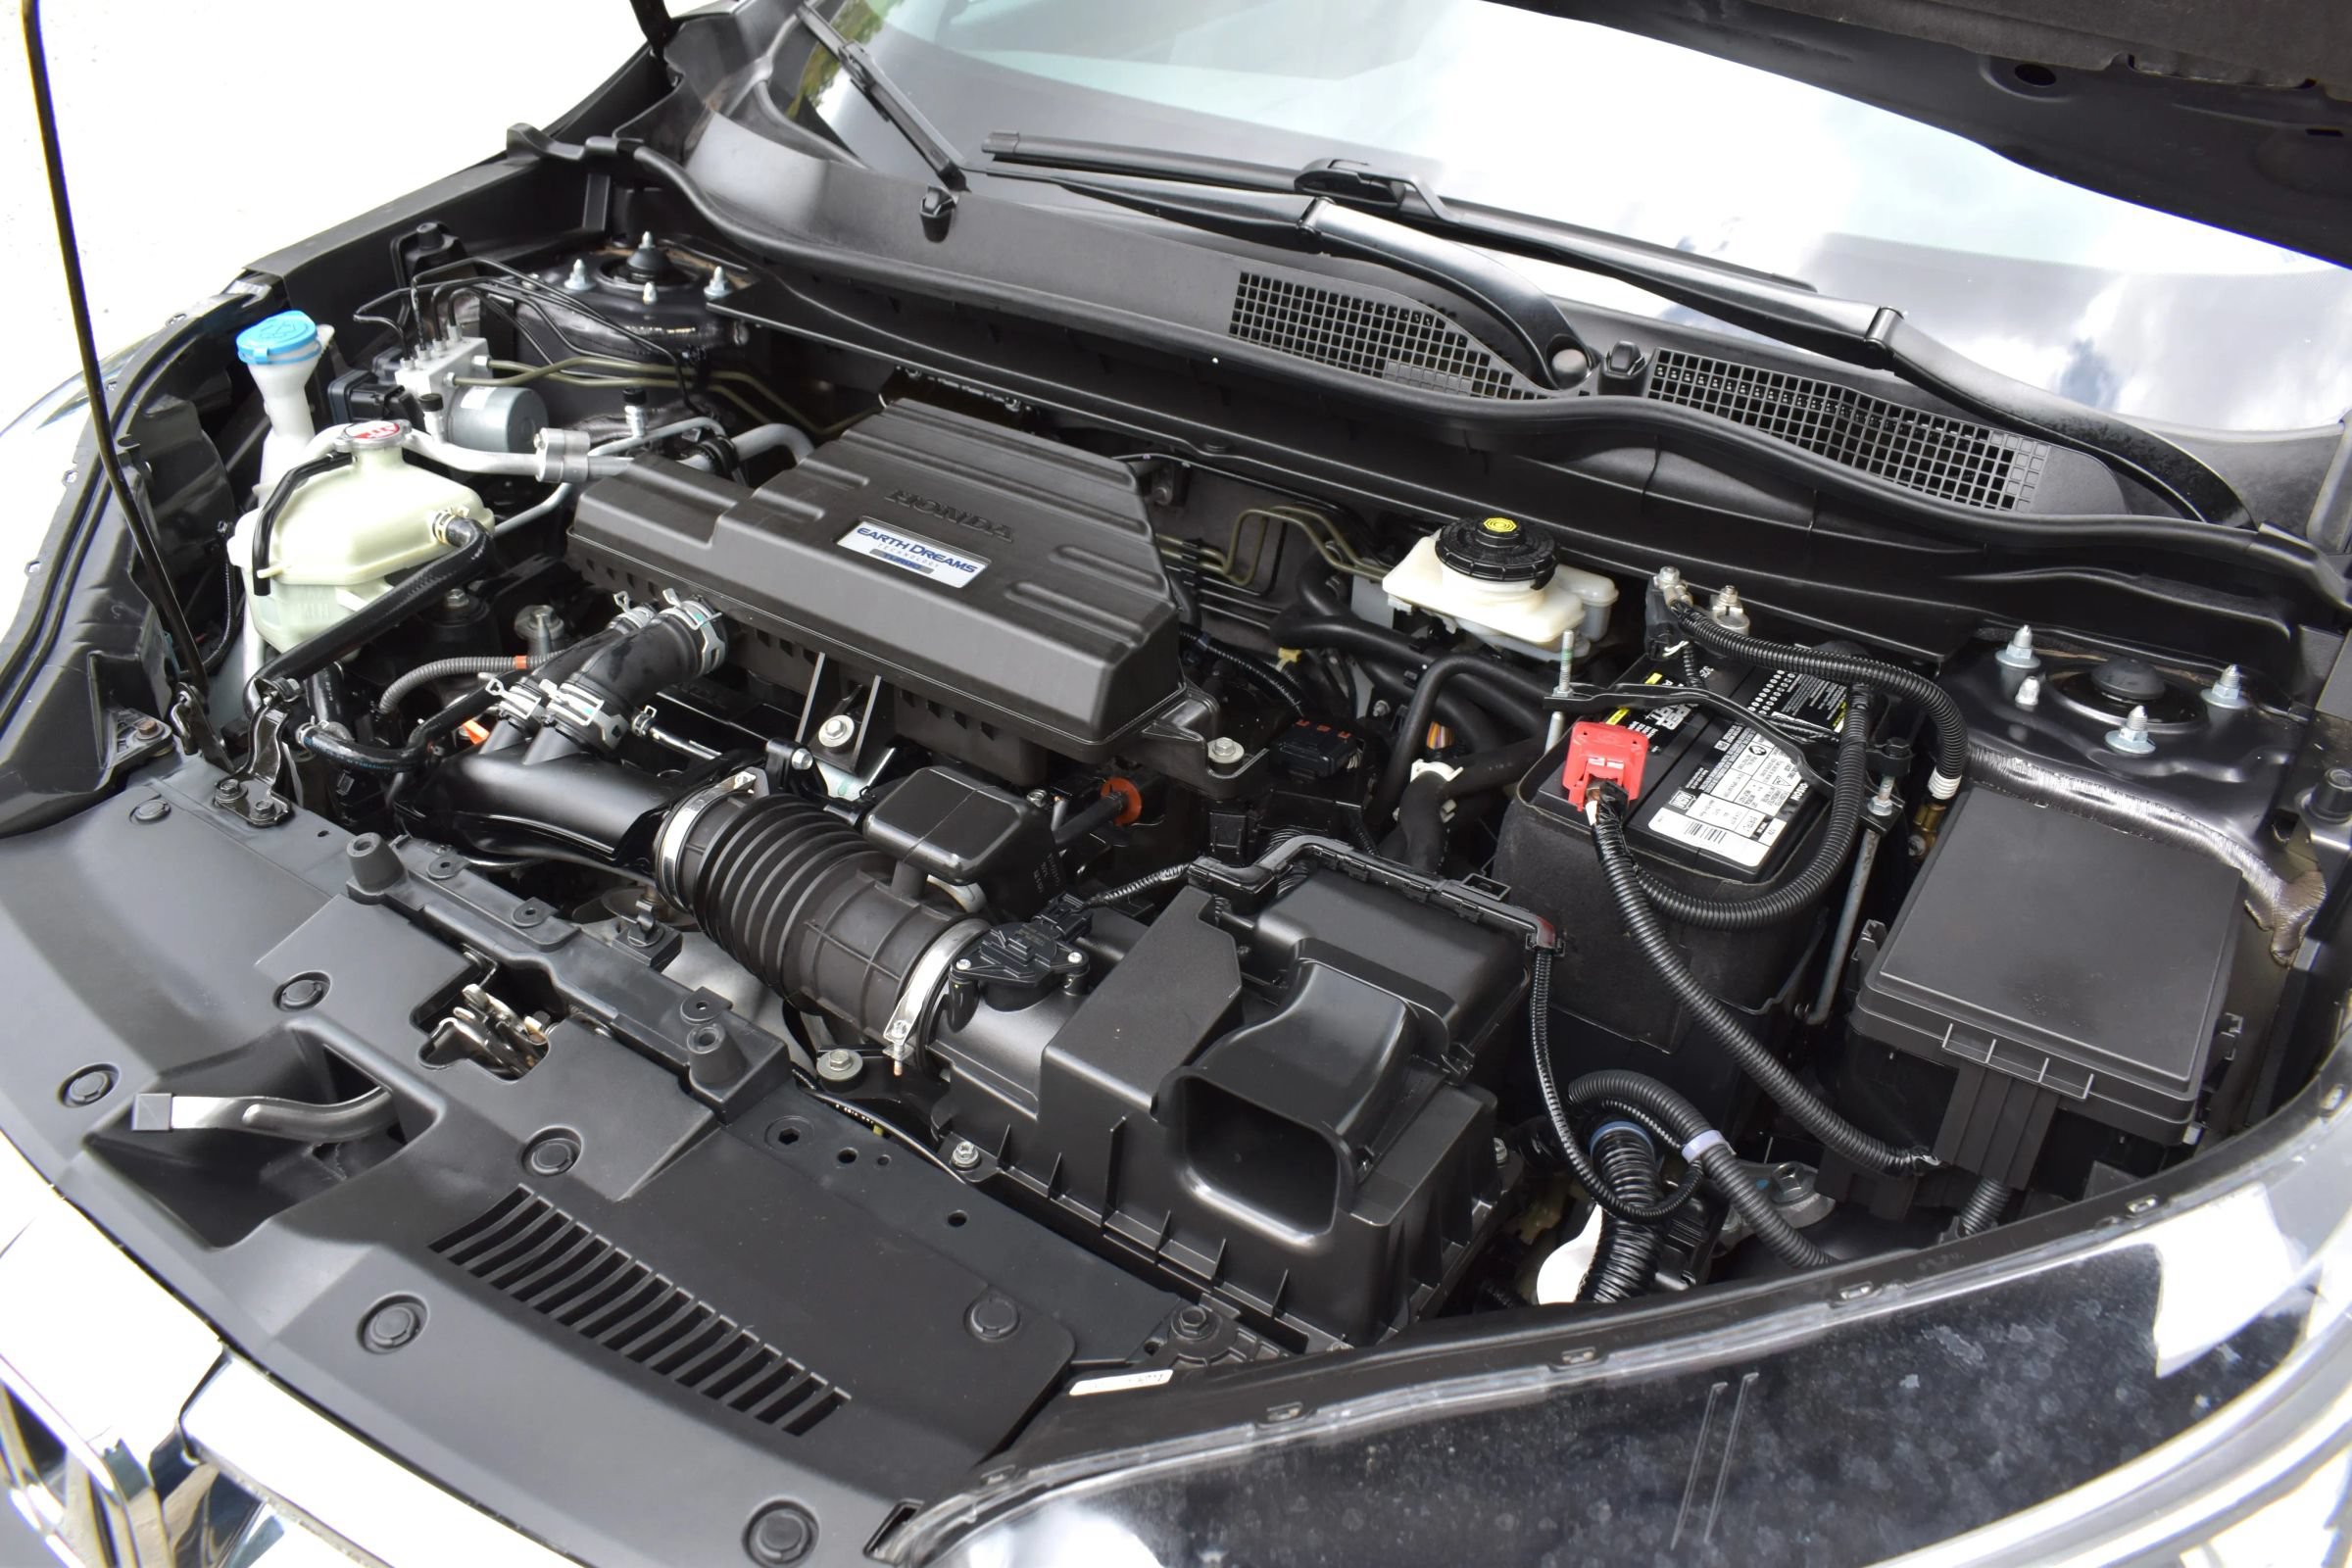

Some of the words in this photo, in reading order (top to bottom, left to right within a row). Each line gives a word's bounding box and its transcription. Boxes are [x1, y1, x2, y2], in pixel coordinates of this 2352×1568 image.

[885, 490, 1012, 542] HONDA
[857, 527, 909, 550] EARTH
[909, 544, 978, 573] DREAMS
